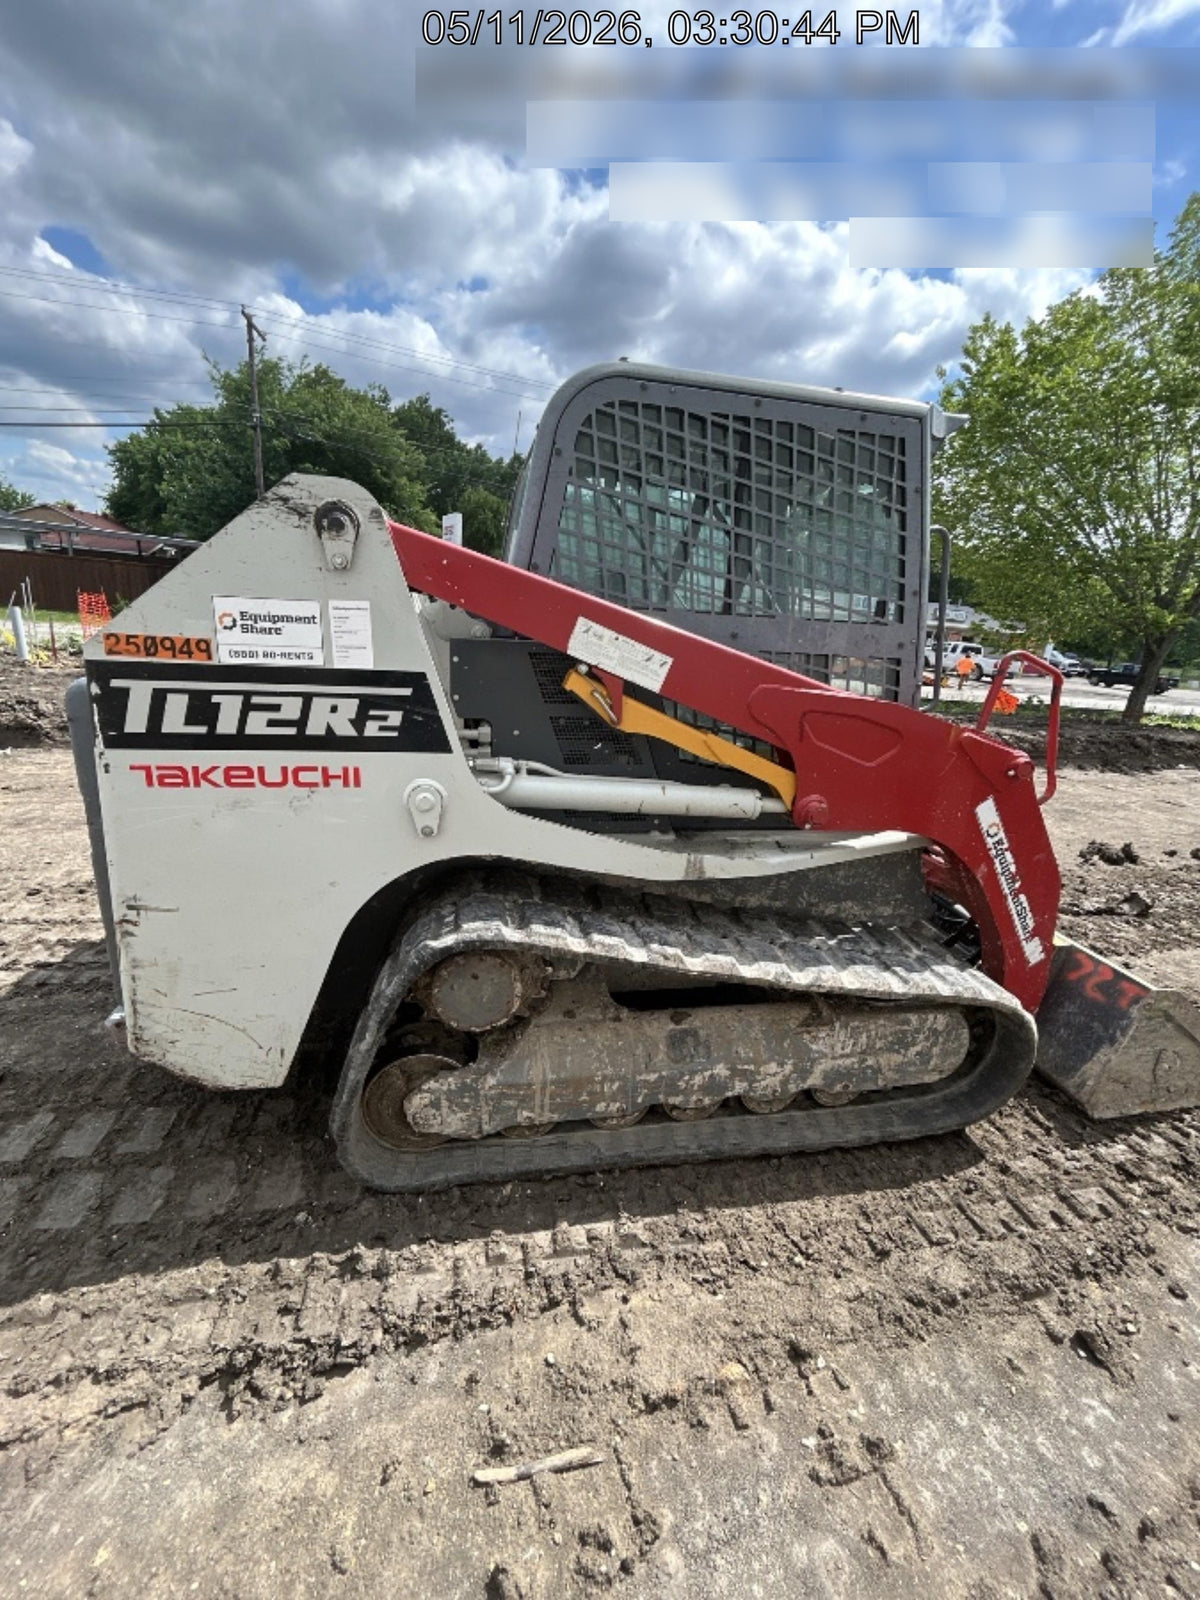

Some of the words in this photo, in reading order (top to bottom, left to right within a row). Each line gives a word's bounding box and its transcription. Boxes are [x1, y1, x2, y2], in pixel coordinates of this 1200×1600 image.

[239, 611, 318, 625] Equipment
[240, 623, 284, 635] Share
[105, 632, 213, 661] 250949
[109, 679, 412, 737] TL12R2
